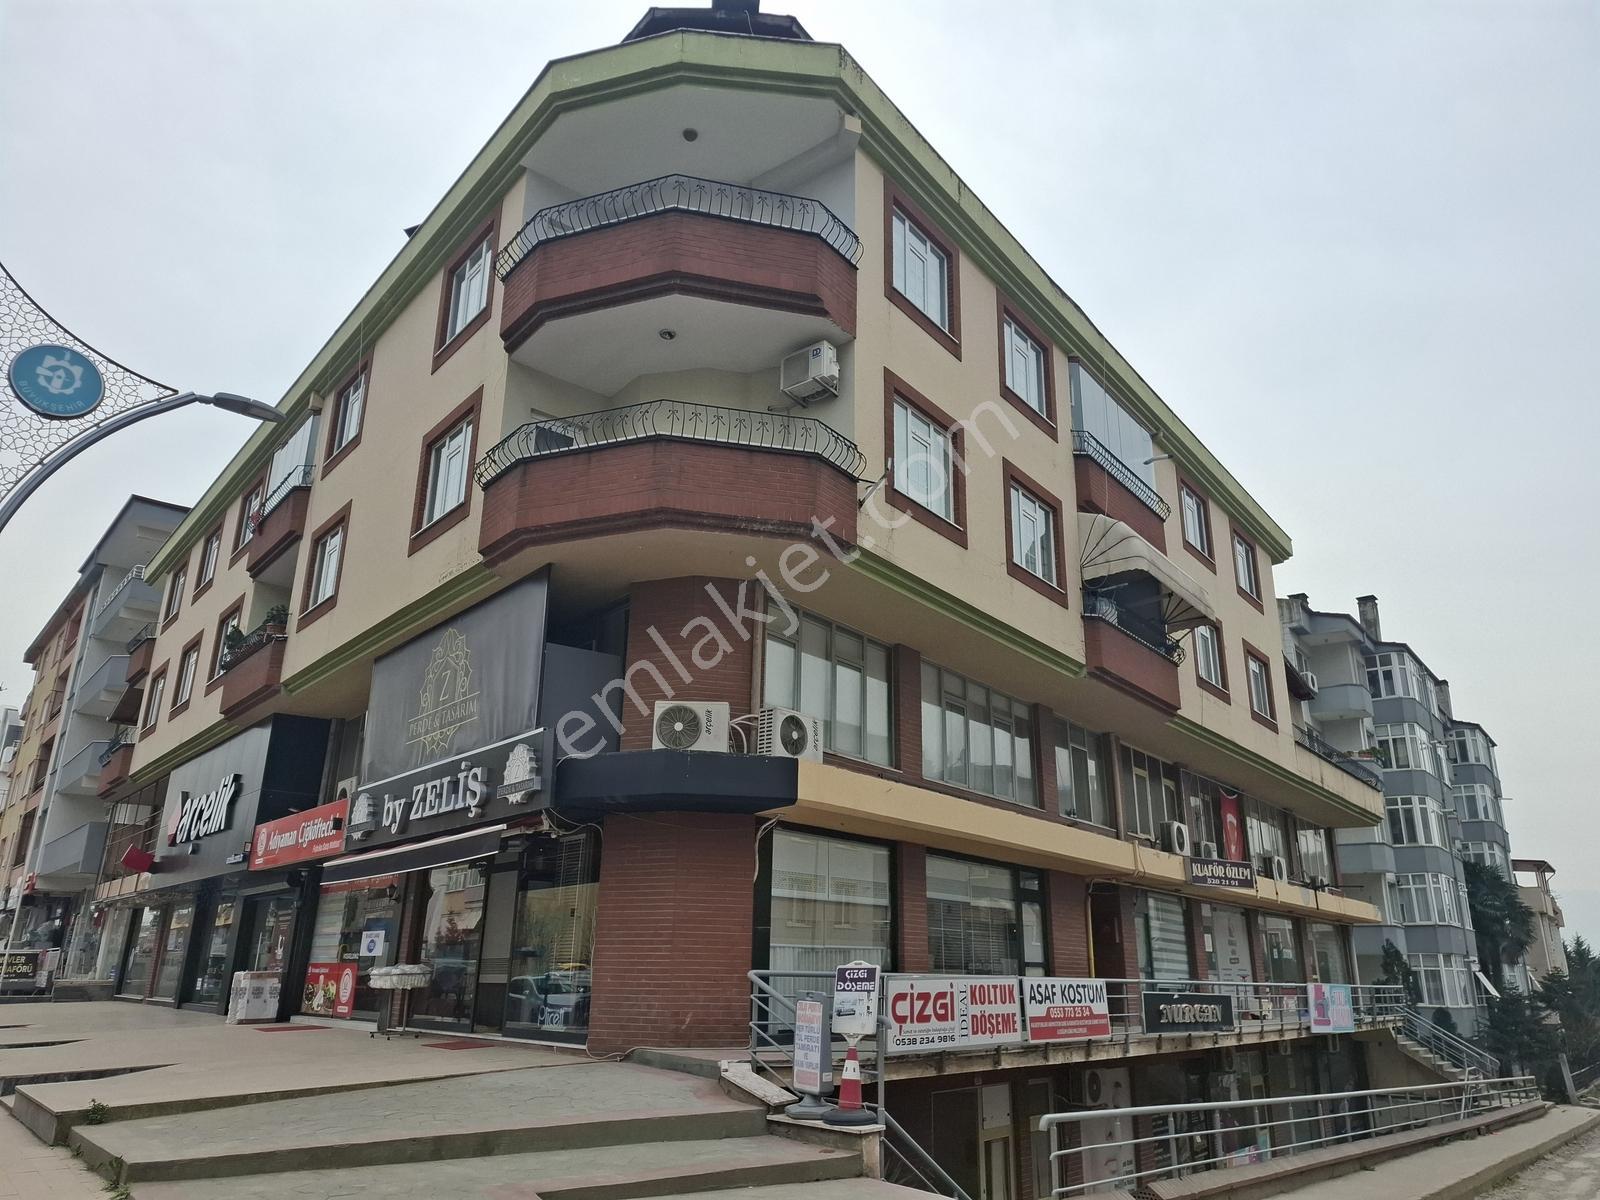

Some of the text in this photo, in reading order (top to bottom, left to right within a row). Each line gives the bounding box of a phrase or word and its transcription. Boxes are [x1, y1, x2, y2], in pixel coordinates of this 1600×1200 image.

[442, 698, 478, 725] TASARIM
[705, 708, 713, 735] arçelik
[382, 761, 484, 834] by ZELİŞ
[1192, 862, 1250, 880] KUAFÖR ÖZLEM
[845, 969, 868, 979] ÇİZGİ
[837, 980, 875, 992] DÖŞEME
[969, 984, 1016, 1005] KOLTUK
[1029, 984, 1105, 1005] ASAF KOSTÜM
[891, 982, 955, 1036] ÇİZGİ
[959, 984, 968, 1038] İDEAL
[1050, 1008, 1063, 1018] 0553
[1083, 1007, 1090, 1016] 34
[971, 1010, 1017, 1039] DÖŞEME
[895, 1034, 956, 1046] 0538 234 9816
